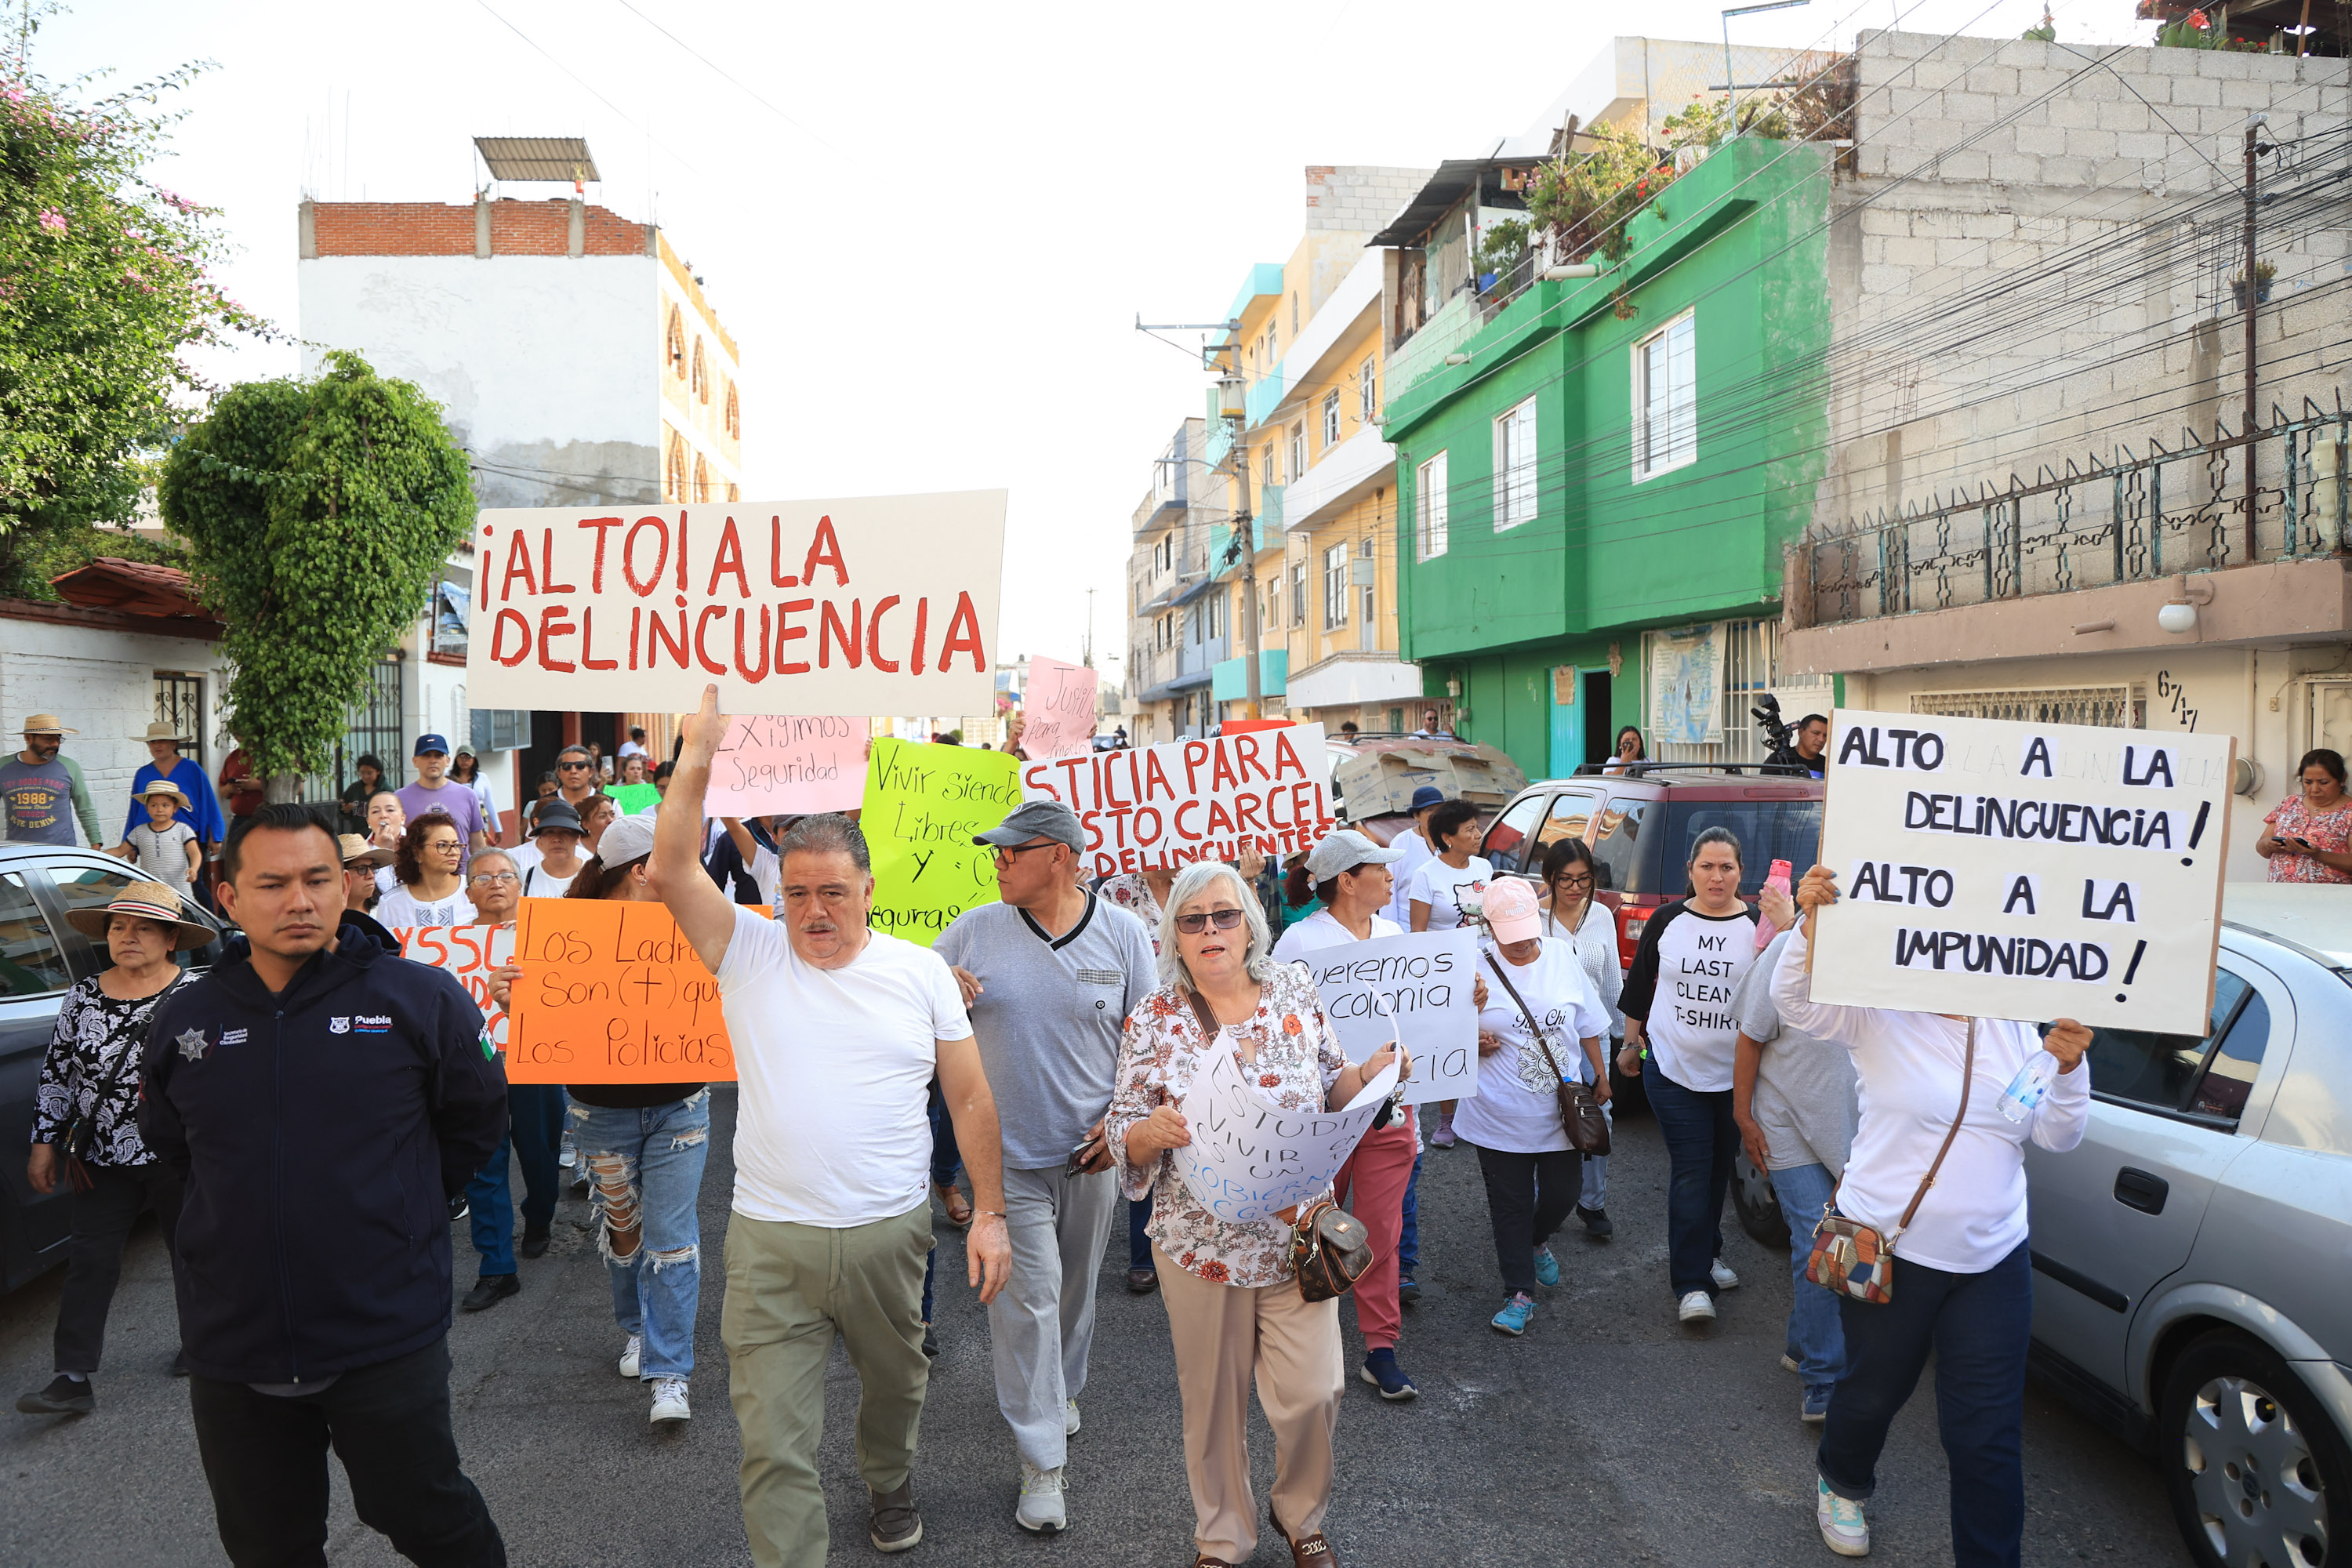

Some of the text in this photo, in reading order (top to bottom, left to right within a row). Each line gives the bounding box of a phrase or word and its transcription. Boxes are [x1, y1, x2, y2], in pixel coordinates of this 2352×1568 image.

[707, 516, 750, 597] A
[771, 515, 849, 587] LA
[490, 590, 985, 684] DELINCUENCIA
[2158, 670, 2198, 734] 6717
[717, 714, 849, 752] xigimos
[730, 751, 838, 793] Seguridad
[876, 744, 936, 793] Vivir
[1184, 731, 1306, 795] PARA
[1838, 726, 1944, 771] ALTO
[2020, 736, 2053, 778] A
[2122, 746, 2173, 787] LA
[16, 793, 46, 804] 1988
[1075, 781, 1336, 853] STO CARCEL
[894, 800, 980, 848] Libres
[1505, 906, 1525, 916] PUMA
[1849, 861, 2136, 922] ALTO A LA
[522, 902, 593, 964] Los
[866, 905, 960, 936] eguras
[1697, 935, 1727, 952] MY
[540, 971, 608, 1007] Son
[1291, 953, 1454, 988] ueremos
[1681, 957, 1734, 978] LAST
[355, 1015, 392, 1024] Puebla
[1330, 981, 1451, 1019] colonia
[517, 1012, 575, 1064] Los
